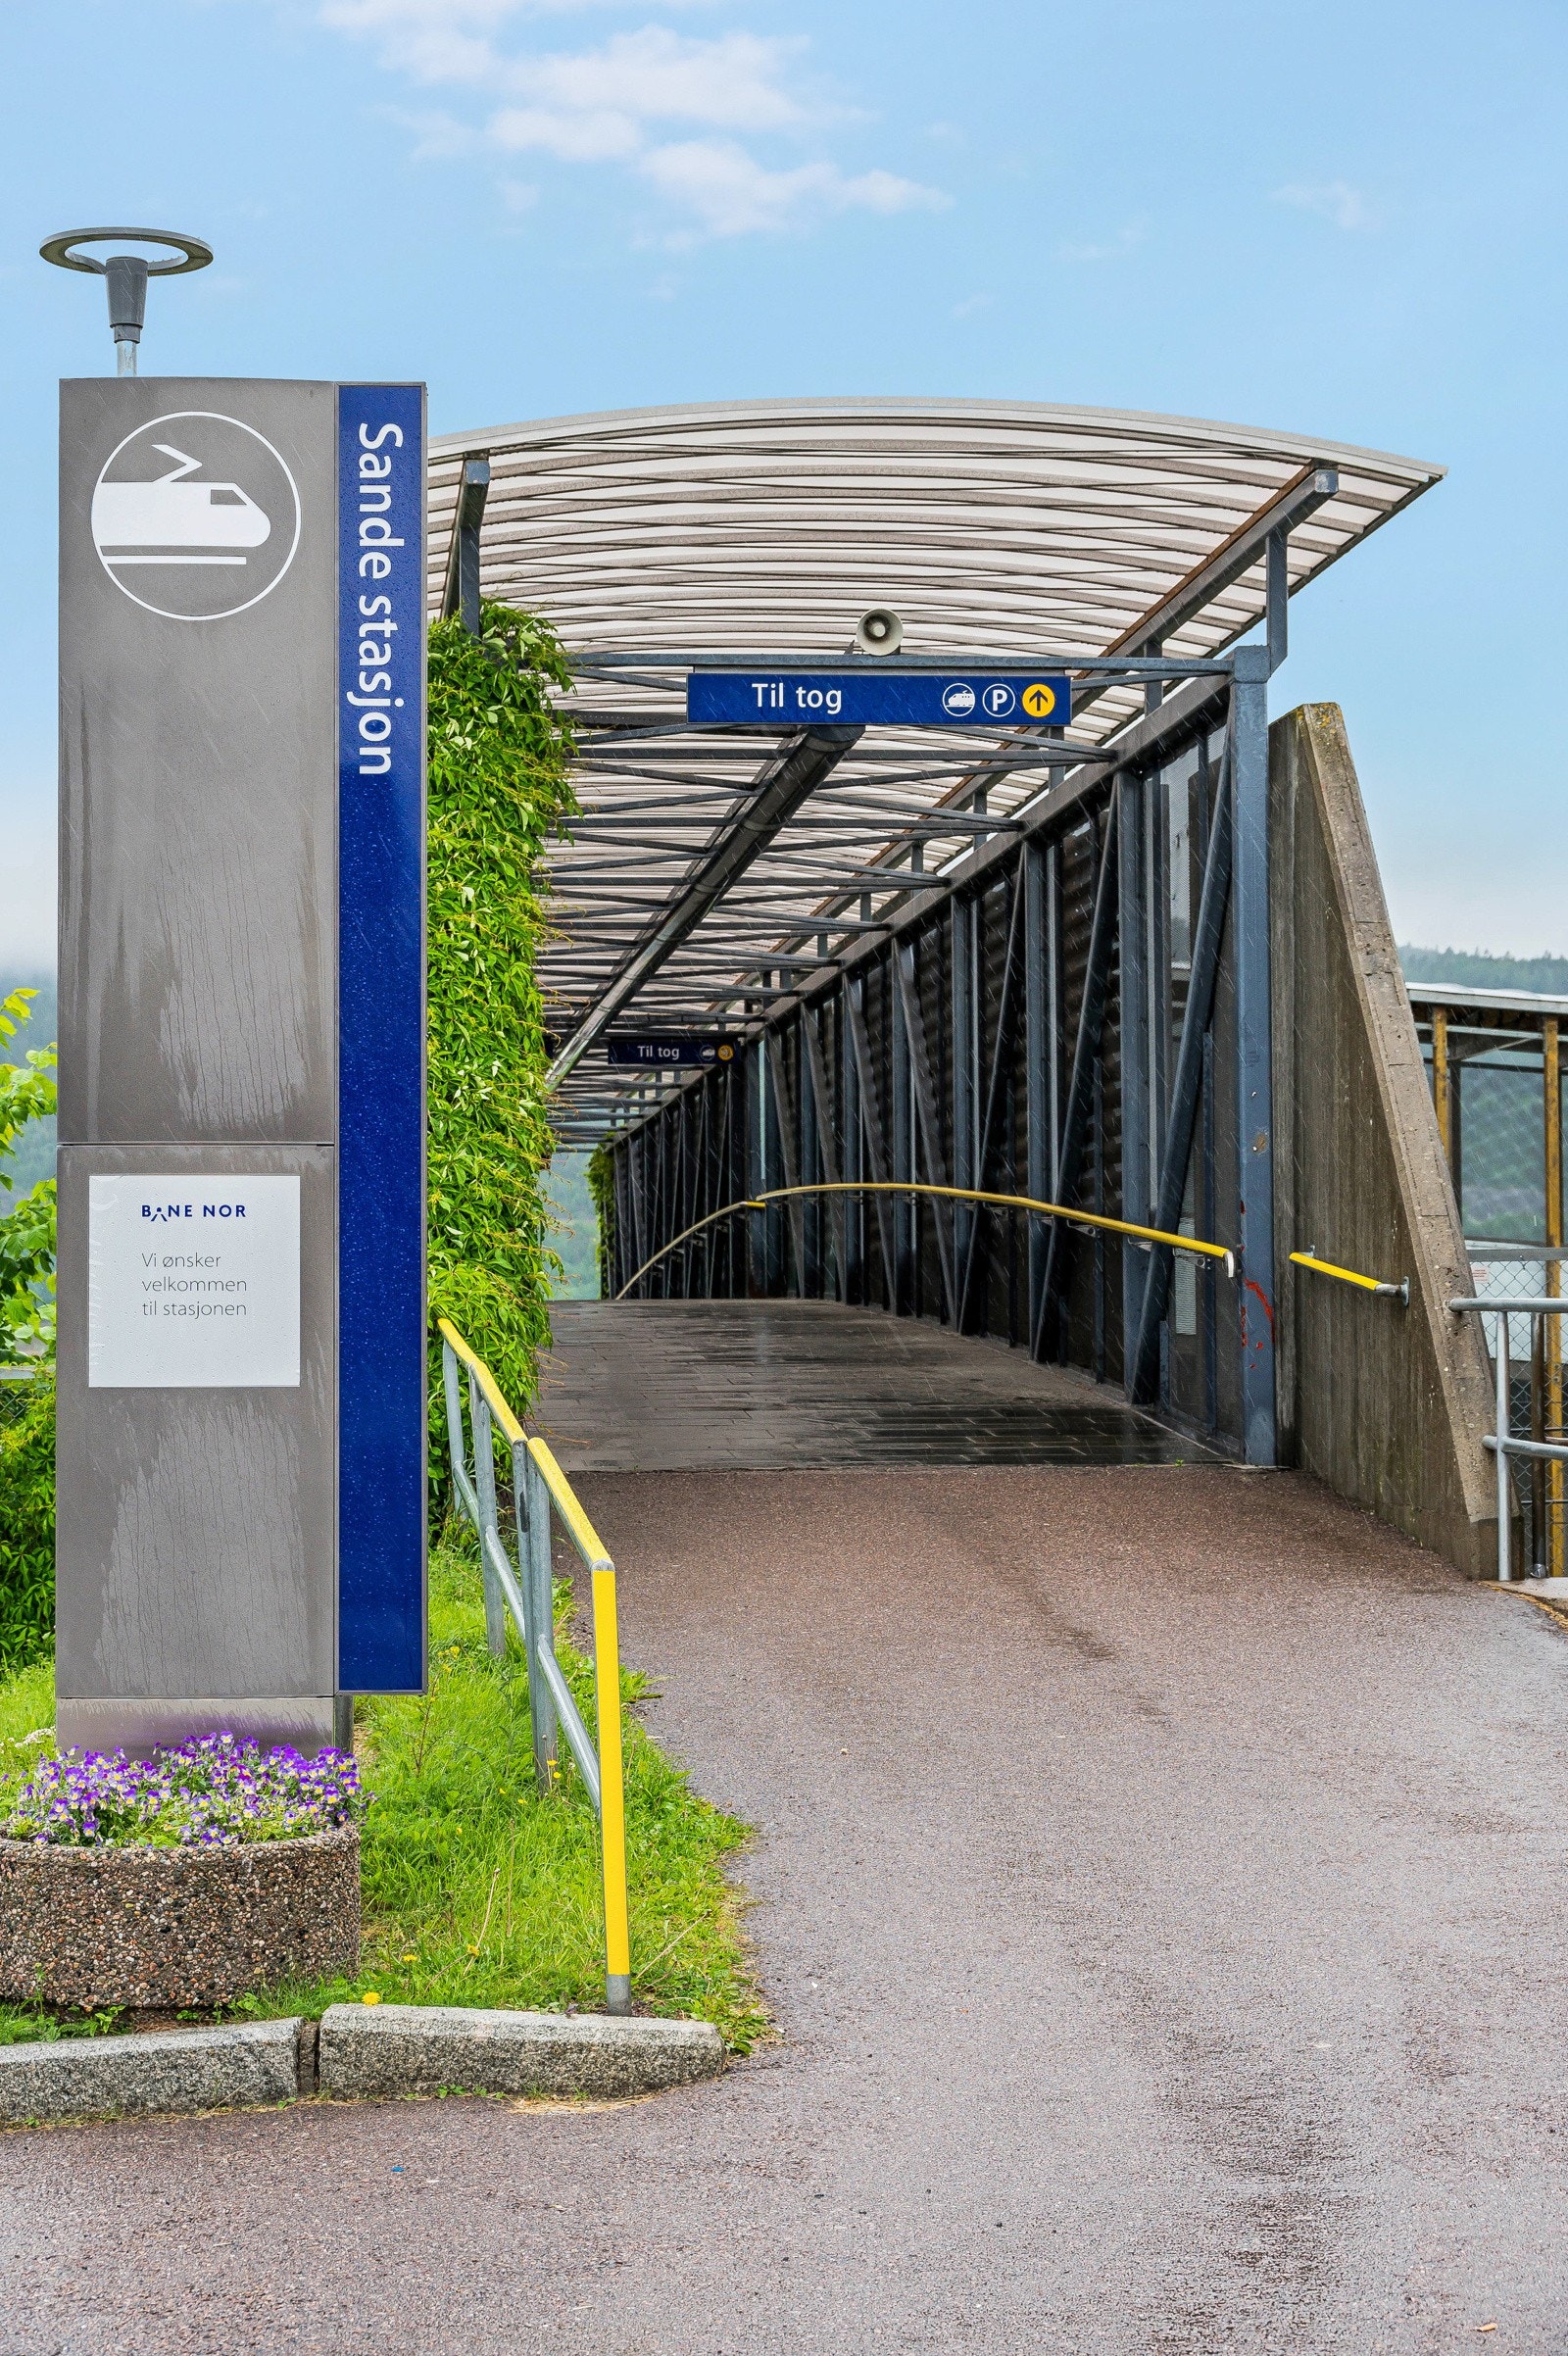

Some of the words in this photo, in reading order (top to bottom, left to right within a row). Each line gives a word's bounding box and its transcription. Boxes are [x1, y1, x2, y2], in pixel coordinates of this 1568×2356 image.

[358, 422, 405, 579] Sande
[347, 594, 405, 774] stasjon
[751, 682, 784, 708] Til
[795, 686, 842, 714] tog
[992, 689, 1008, 712] P
[637, 1045, 654, 1057] Til
[658, 1046, 680, 1060] tog
[141, 1204, 193, 1222] BANE
[203, 1203, 247, 1218] NOR
[141, 1252, 157, 1268] Vi
[162, 1252, 221, 1268] ønsker
[141, 1276, 247, 1293] velkommen
[142, 1300, 158, 1316] til
[163, 1301, 247, 1320] stasjonen
